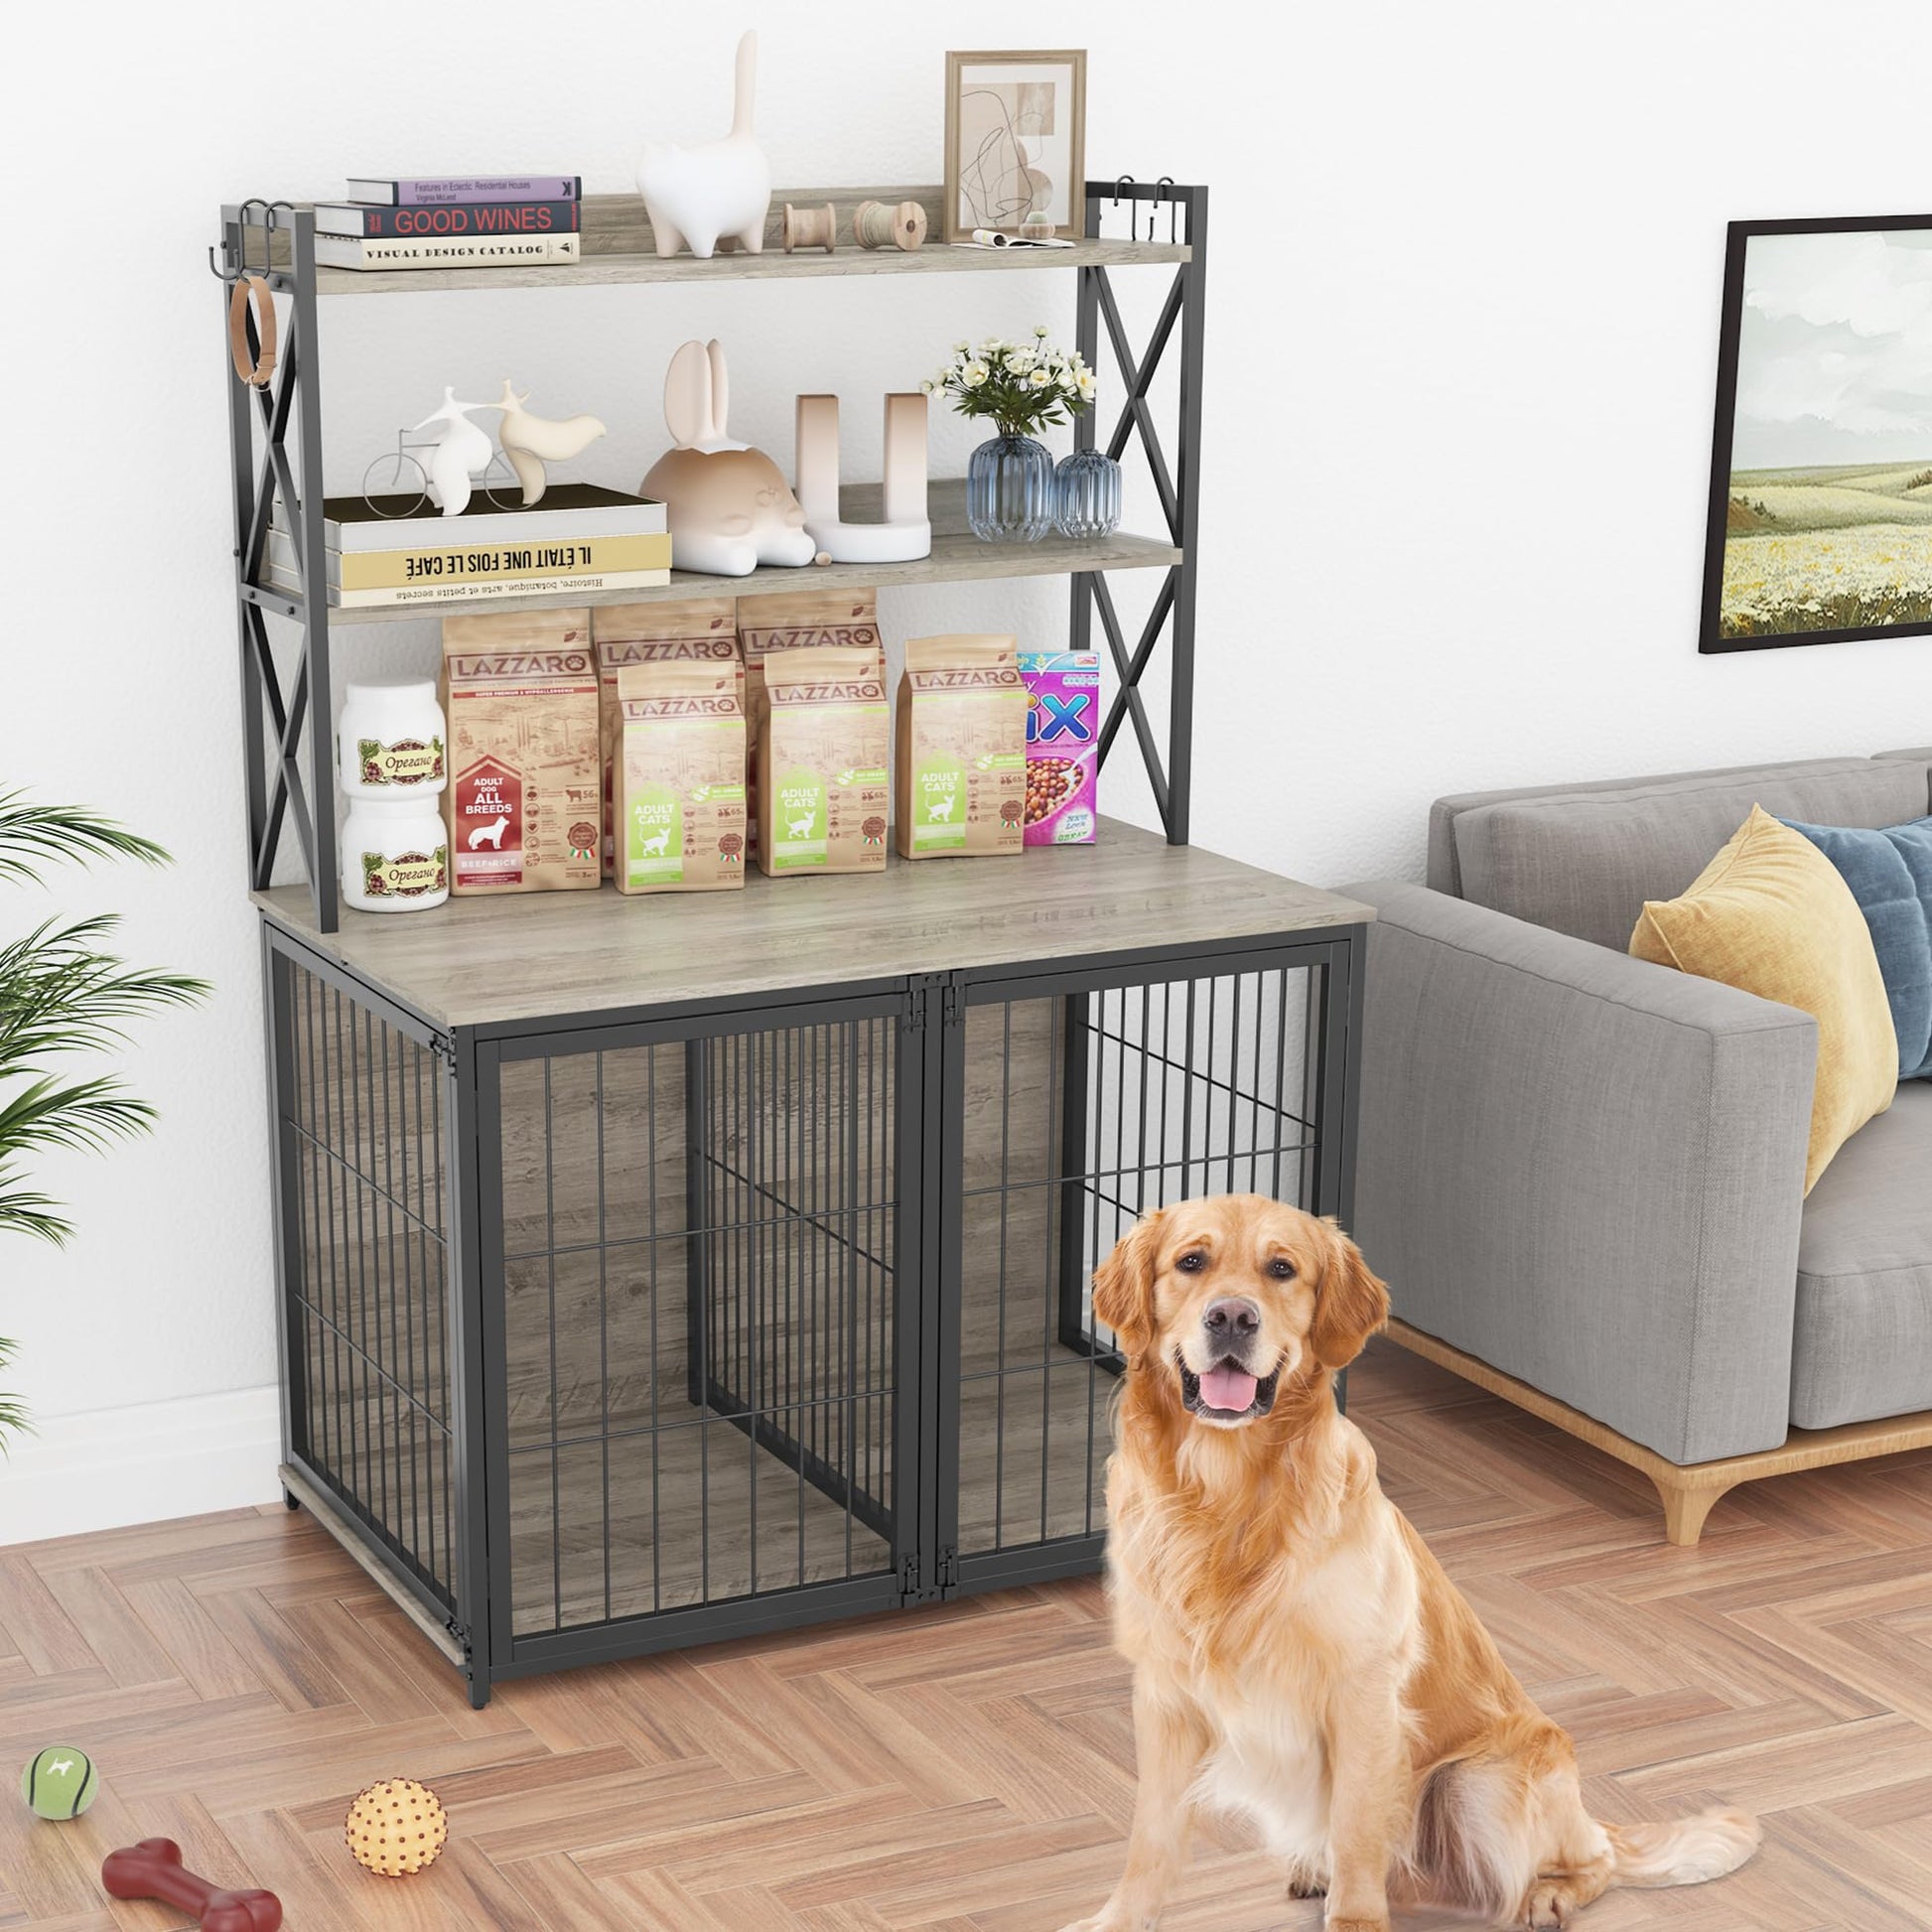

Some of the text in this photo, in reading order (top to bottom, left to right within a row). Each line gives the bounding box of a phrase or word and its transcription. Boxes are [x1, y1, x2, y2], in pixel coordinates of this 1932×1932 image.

[414, 183, 442, 192] Features
[475, 181, 507, 190] Residential
[507, 180, 531, 189] Houses
[395, 209, 469, 233] GOOD
[474, 207, 552, 231] WINES
[366, 249, 420, 258] VISUAL
[425, 247, 476, 257] DESIGN
[480, 245, 543, 255] CATALOG
[405, 546, 591, 581] IL ÉTAIT UNE FOIS LE CAFÉ
[505, 581, 557, 592] botanique,
[560, 578, 604, 588] Histoire,
[396, 590, 434, 601] secrets
[437, 587, 467, 598] petits
[751, 627, 874, 649] LAZZARO
[607, 640, 733, 663] LAZZARO
[457, 654, 586, 676] LAZZARO
[915, 671, 1018, 687] LAZZARO
[773, 684, 880, 702] LAZZARO
[627, 698, 735, 717] LAZZARO
[385, 756, 432, 772] Орегано
[474, 777, 504, 786] ADULT
[921, 772, 959, 782] ADULT
[780, 787, 820, 798] ADULT
[924, 782, 955, 792] CATS
[475, 792, 503, 804] ALL
[784, 798, 816, 808] CATS
[466, 803, 513, 814] BREEDS
[634, 803, 674, 815] ADULT
[638, 815, 671, 825] CATS
[388, 868, 435, 885] Орегано
